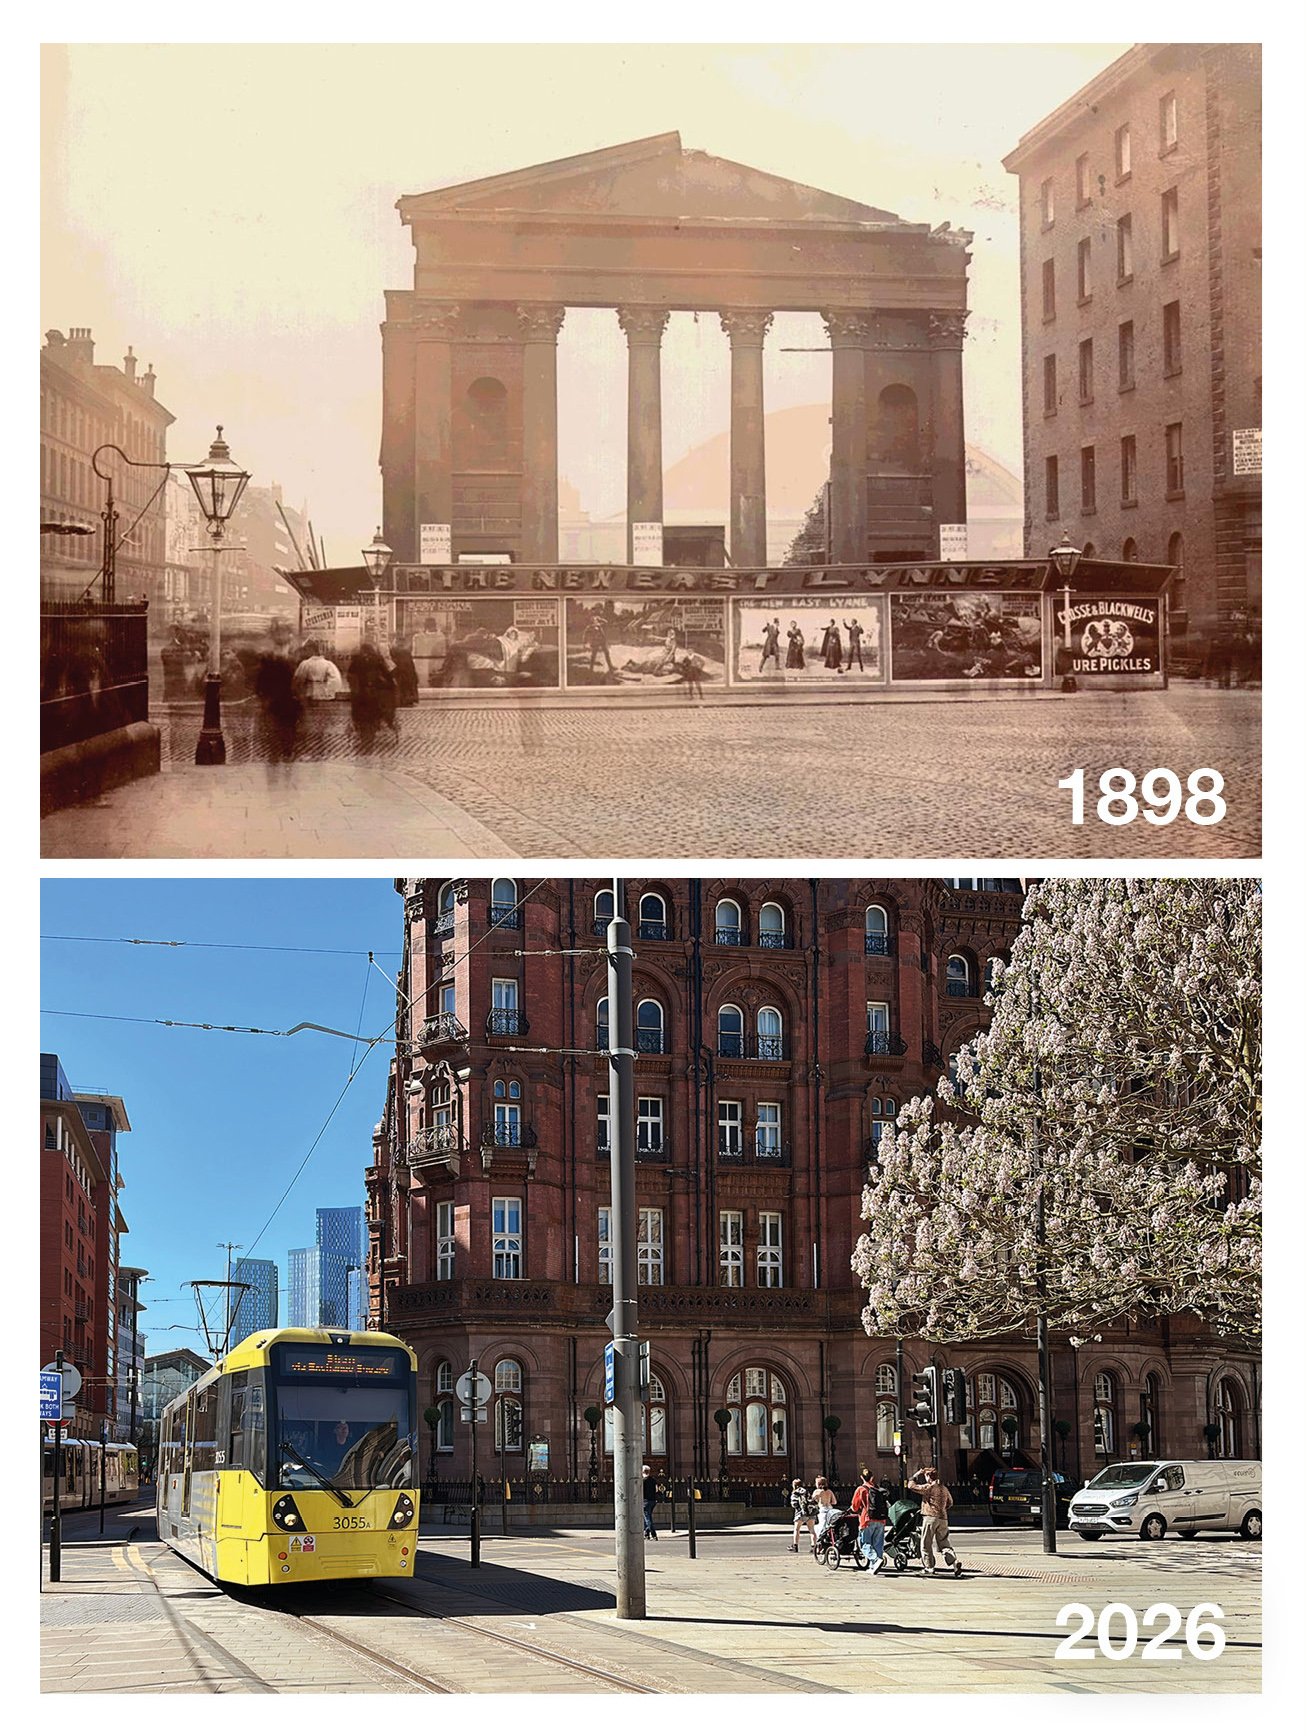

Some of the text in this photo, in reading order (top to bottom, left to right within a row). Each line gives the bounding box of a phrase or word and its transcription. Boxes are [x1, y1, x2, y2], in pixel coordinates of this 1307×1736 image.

[436, 567, 1007, 591] THE NEW EAST LYNNE
[761, 599, 783, 607] NEW
[792, 598, 820, 607] EAST
[829, 597, 869, 607] LYNNE
[1072, 658, 1151, 671] URE PICKLES
